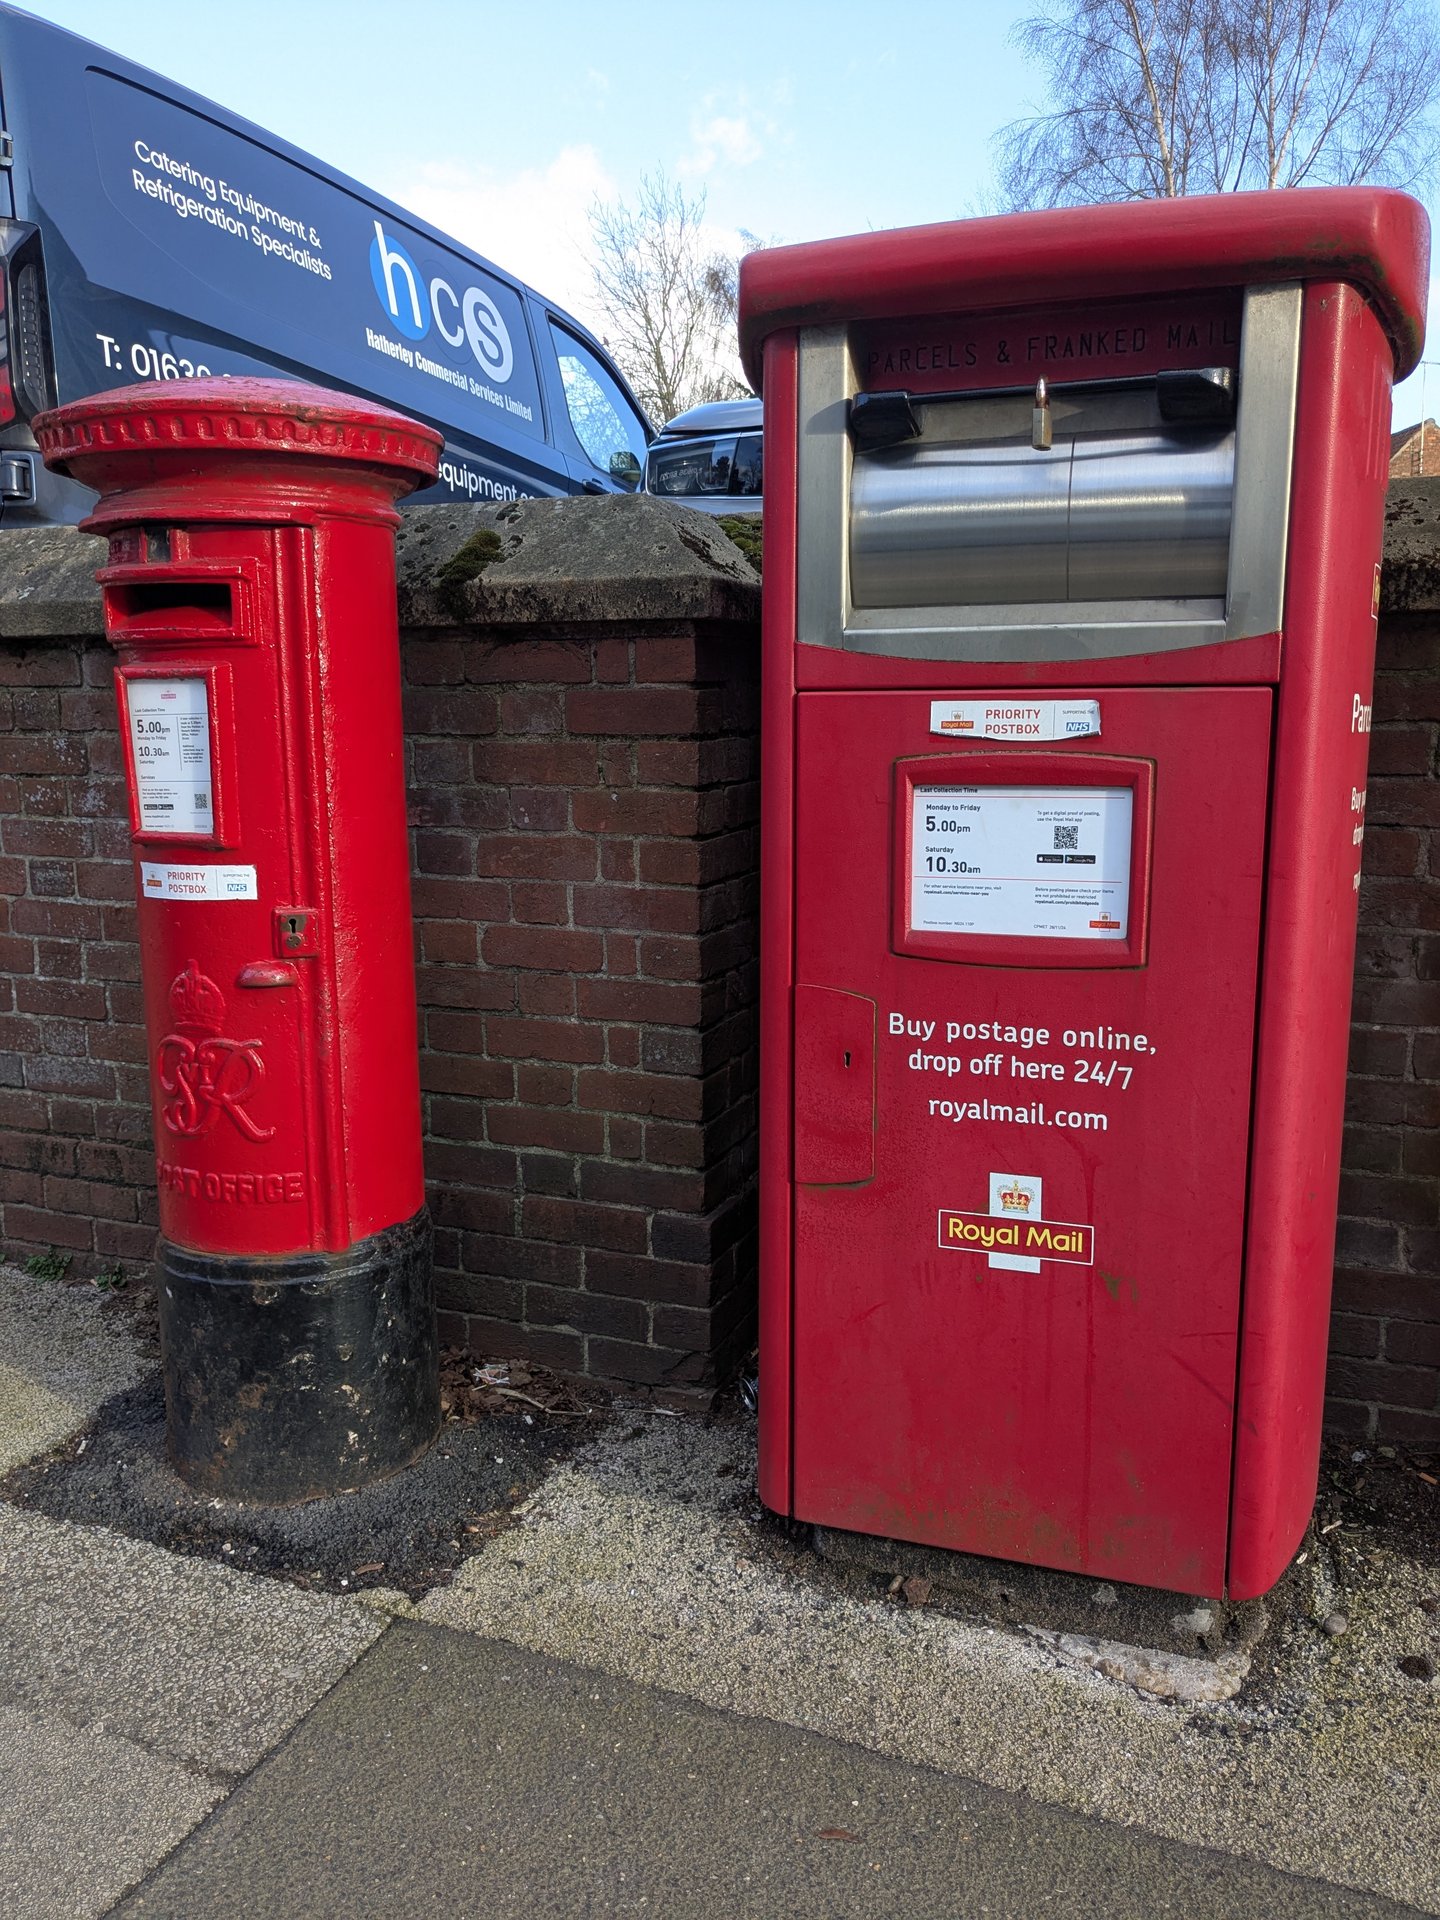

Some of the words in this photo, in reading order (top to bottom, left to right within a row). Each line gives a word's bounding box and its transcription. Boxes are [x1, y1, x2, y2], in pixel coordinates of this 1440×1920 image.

[134, 140, 217, 202] Catering
[218, 180, 313, 243] Equipment
[309, 227, 322, 249] &
[132, 169, 249, 241] Refrigeration
[250, 225, 333, 281] Specialists
[96, 333, 123, 371] T:
[868, 343, 977, 374] PARCELS
[996, 340, 1011, 363] &
[1027, 327, 1146, 361] FRANKED
[1167, 319, 1236, 349] MAIL
[366, 327, 414, 368] Hatherley
[415, 351, 469, 392] Commercial
[469, 378, 504, 408] Services
[504, 394, 533, 423] Limited
[985, 709, 1041, 720] PRIORITY
[137, 719, 171, 734] 5.00pm
[985, 724, 1040, 734] POSTBOX
[1067, 722, 1090, 731] NHS
[138, 746, 170, 757] 10.30am
[926, 804, 951, 812] Monday
[960, 804, 981, 812] Friday
[926, 816, 971, 834] 5.00pm
[925, 846, 954, 854] Saturday
[926, 856, 981, 874] 10.30am
[167, 871, 206, 881] PRIORITY
[168, 884, 207, 893] POSTBOX
[888, 1012, 936, 1042] Buy
[946, 1021, 1050, 1049] postage
[1062, 1026, 1157, 1055] online,
[908, 1049, 961, 1077] drop
[969, 1053, 1004, 1076] off
[1011, 1056, 1065, 1081] here
[1073, 1059, 1133, 1090] 24/7
[928, 1098, 1108, 1131] royalmail.com
[203, 1172, 304, 1204] OFFICE
[949, 1217, 1019, 1247] Royal
[1025, 1226, 1083, 1253] Mail
